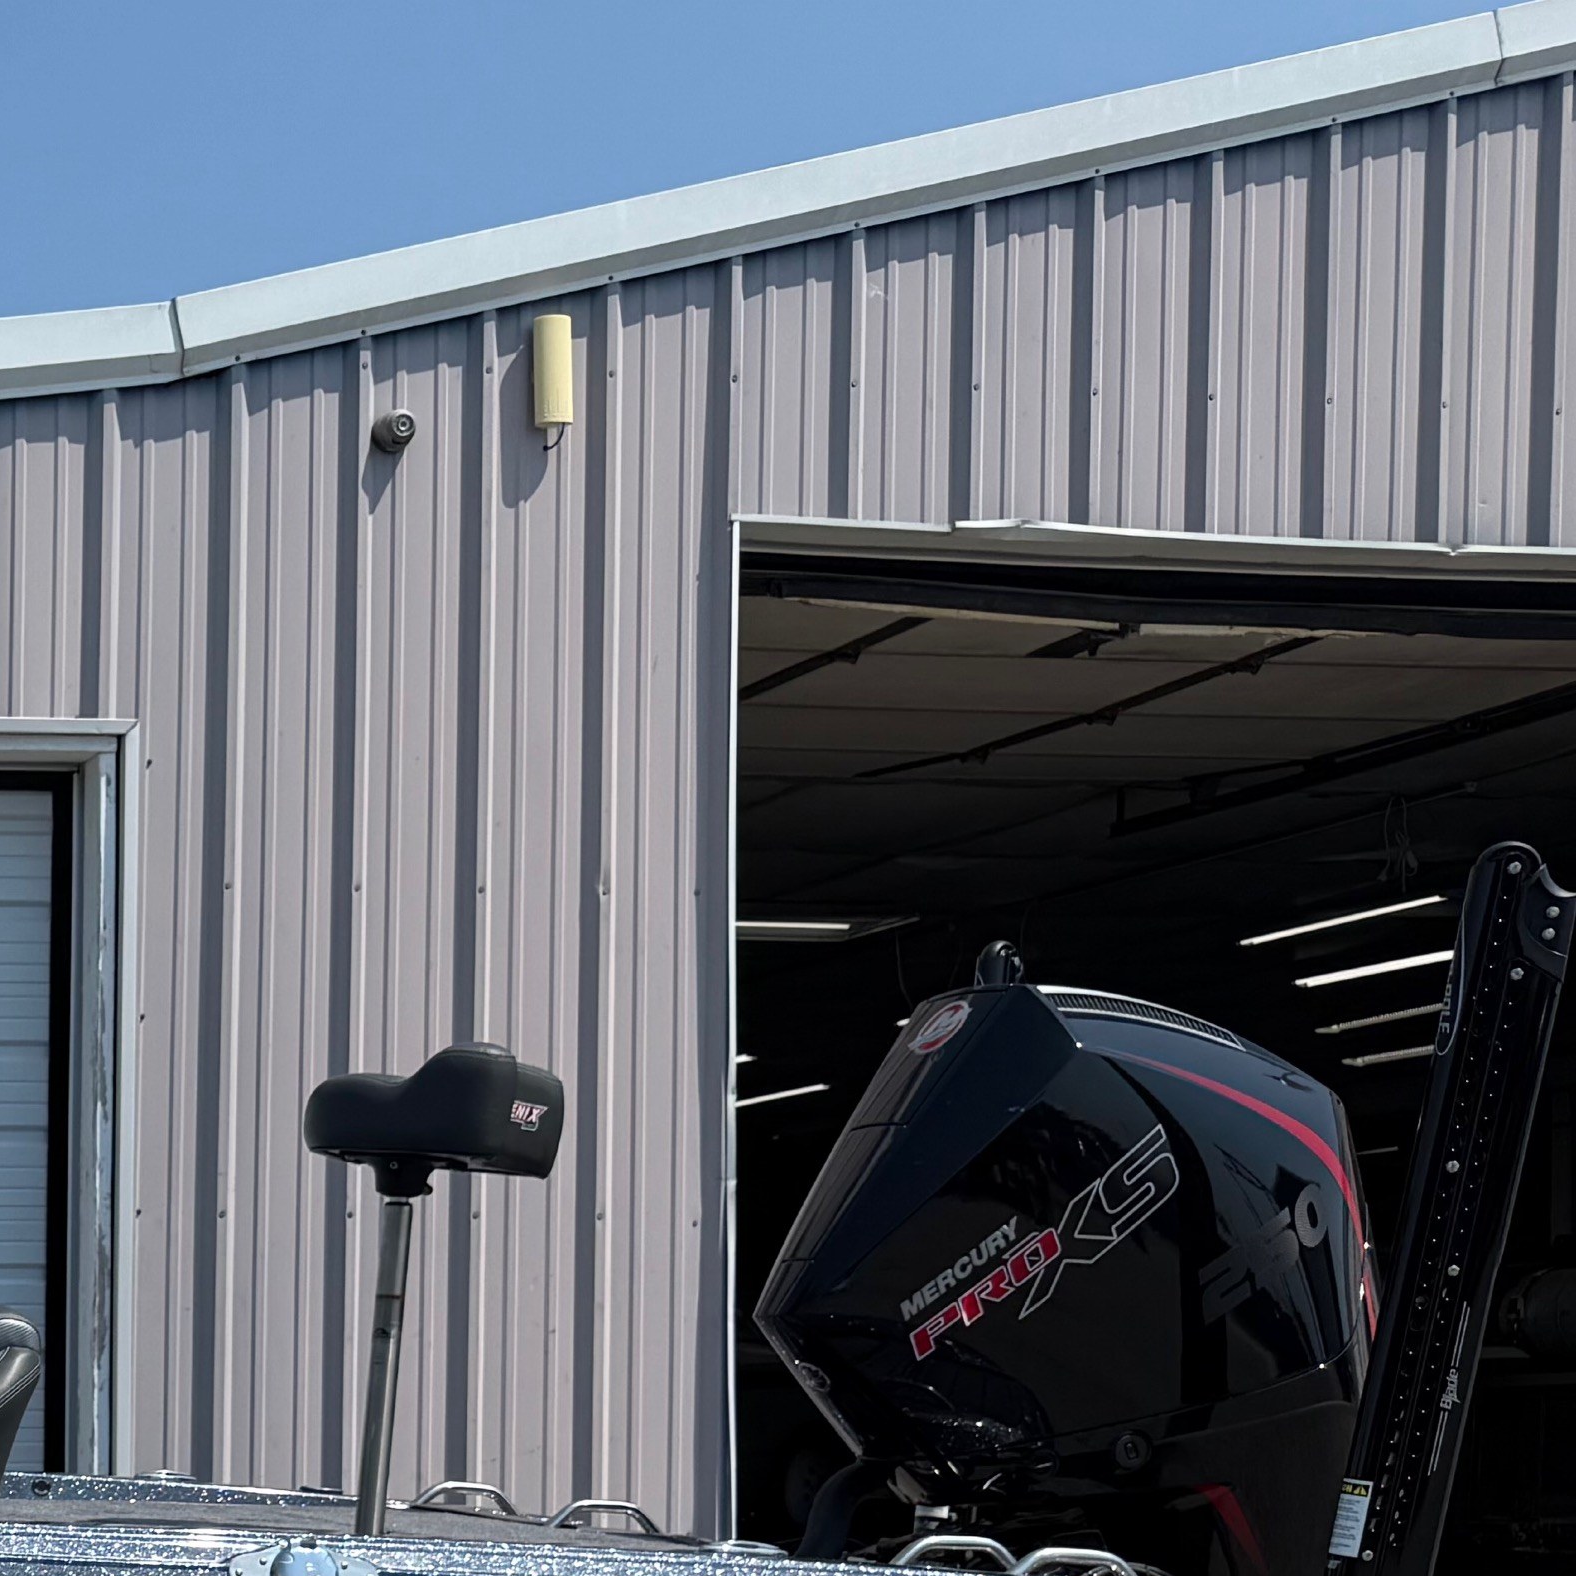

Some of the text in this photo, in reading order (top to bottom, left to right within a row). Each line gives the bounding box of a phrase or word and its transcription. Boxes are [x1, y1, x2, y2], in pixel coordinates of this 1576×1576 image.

[899, 1216, 1018, 1321] MERCURY
[1198, 1183, 1329, 1327] 250
[1440, 1368, 1461, 1410] Blade
